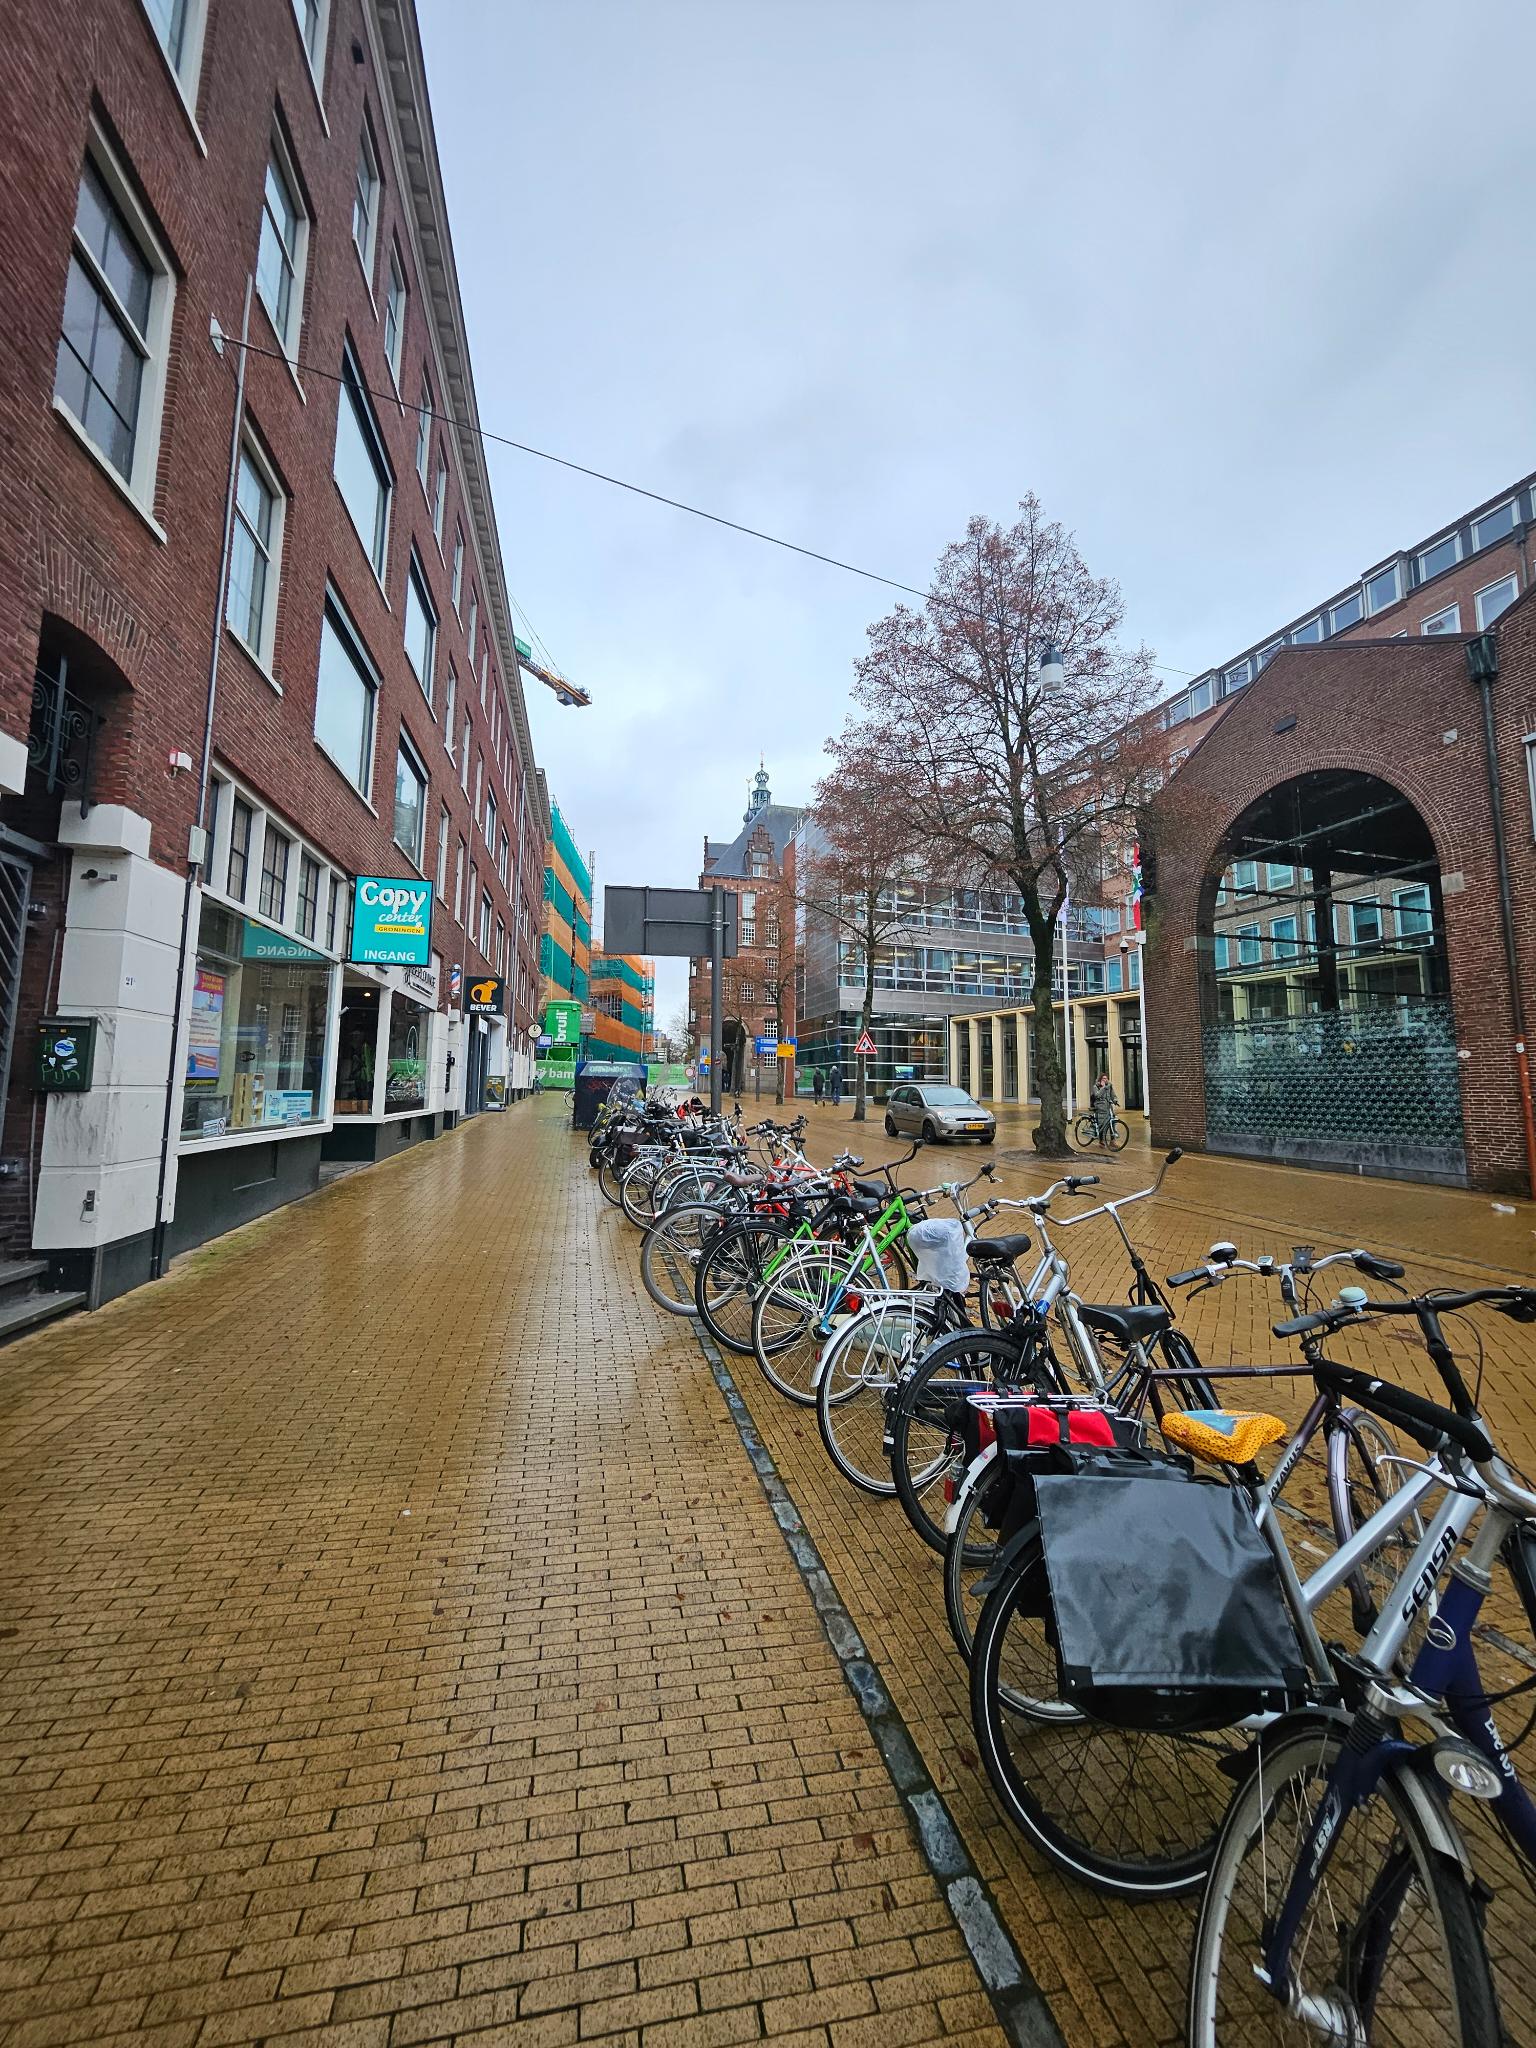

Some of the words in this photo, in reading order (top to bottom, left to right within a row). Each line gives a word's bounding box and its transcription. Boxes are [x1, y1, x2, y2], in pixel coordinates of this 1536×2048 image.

[360, 881, 427, 915] Copy
[379, 912, 422, 922] center
[364, 949, 416, 961] INGANG
[470, 1004, 497, 1012] BEVER
[548, 1067, 574, 1079] bam
[1268, 1443, 1302, 1501] ATAVUS
[1402, 1525, 1458, 1629] SENSA
[1314, 1816, 1333, 1860] RST
